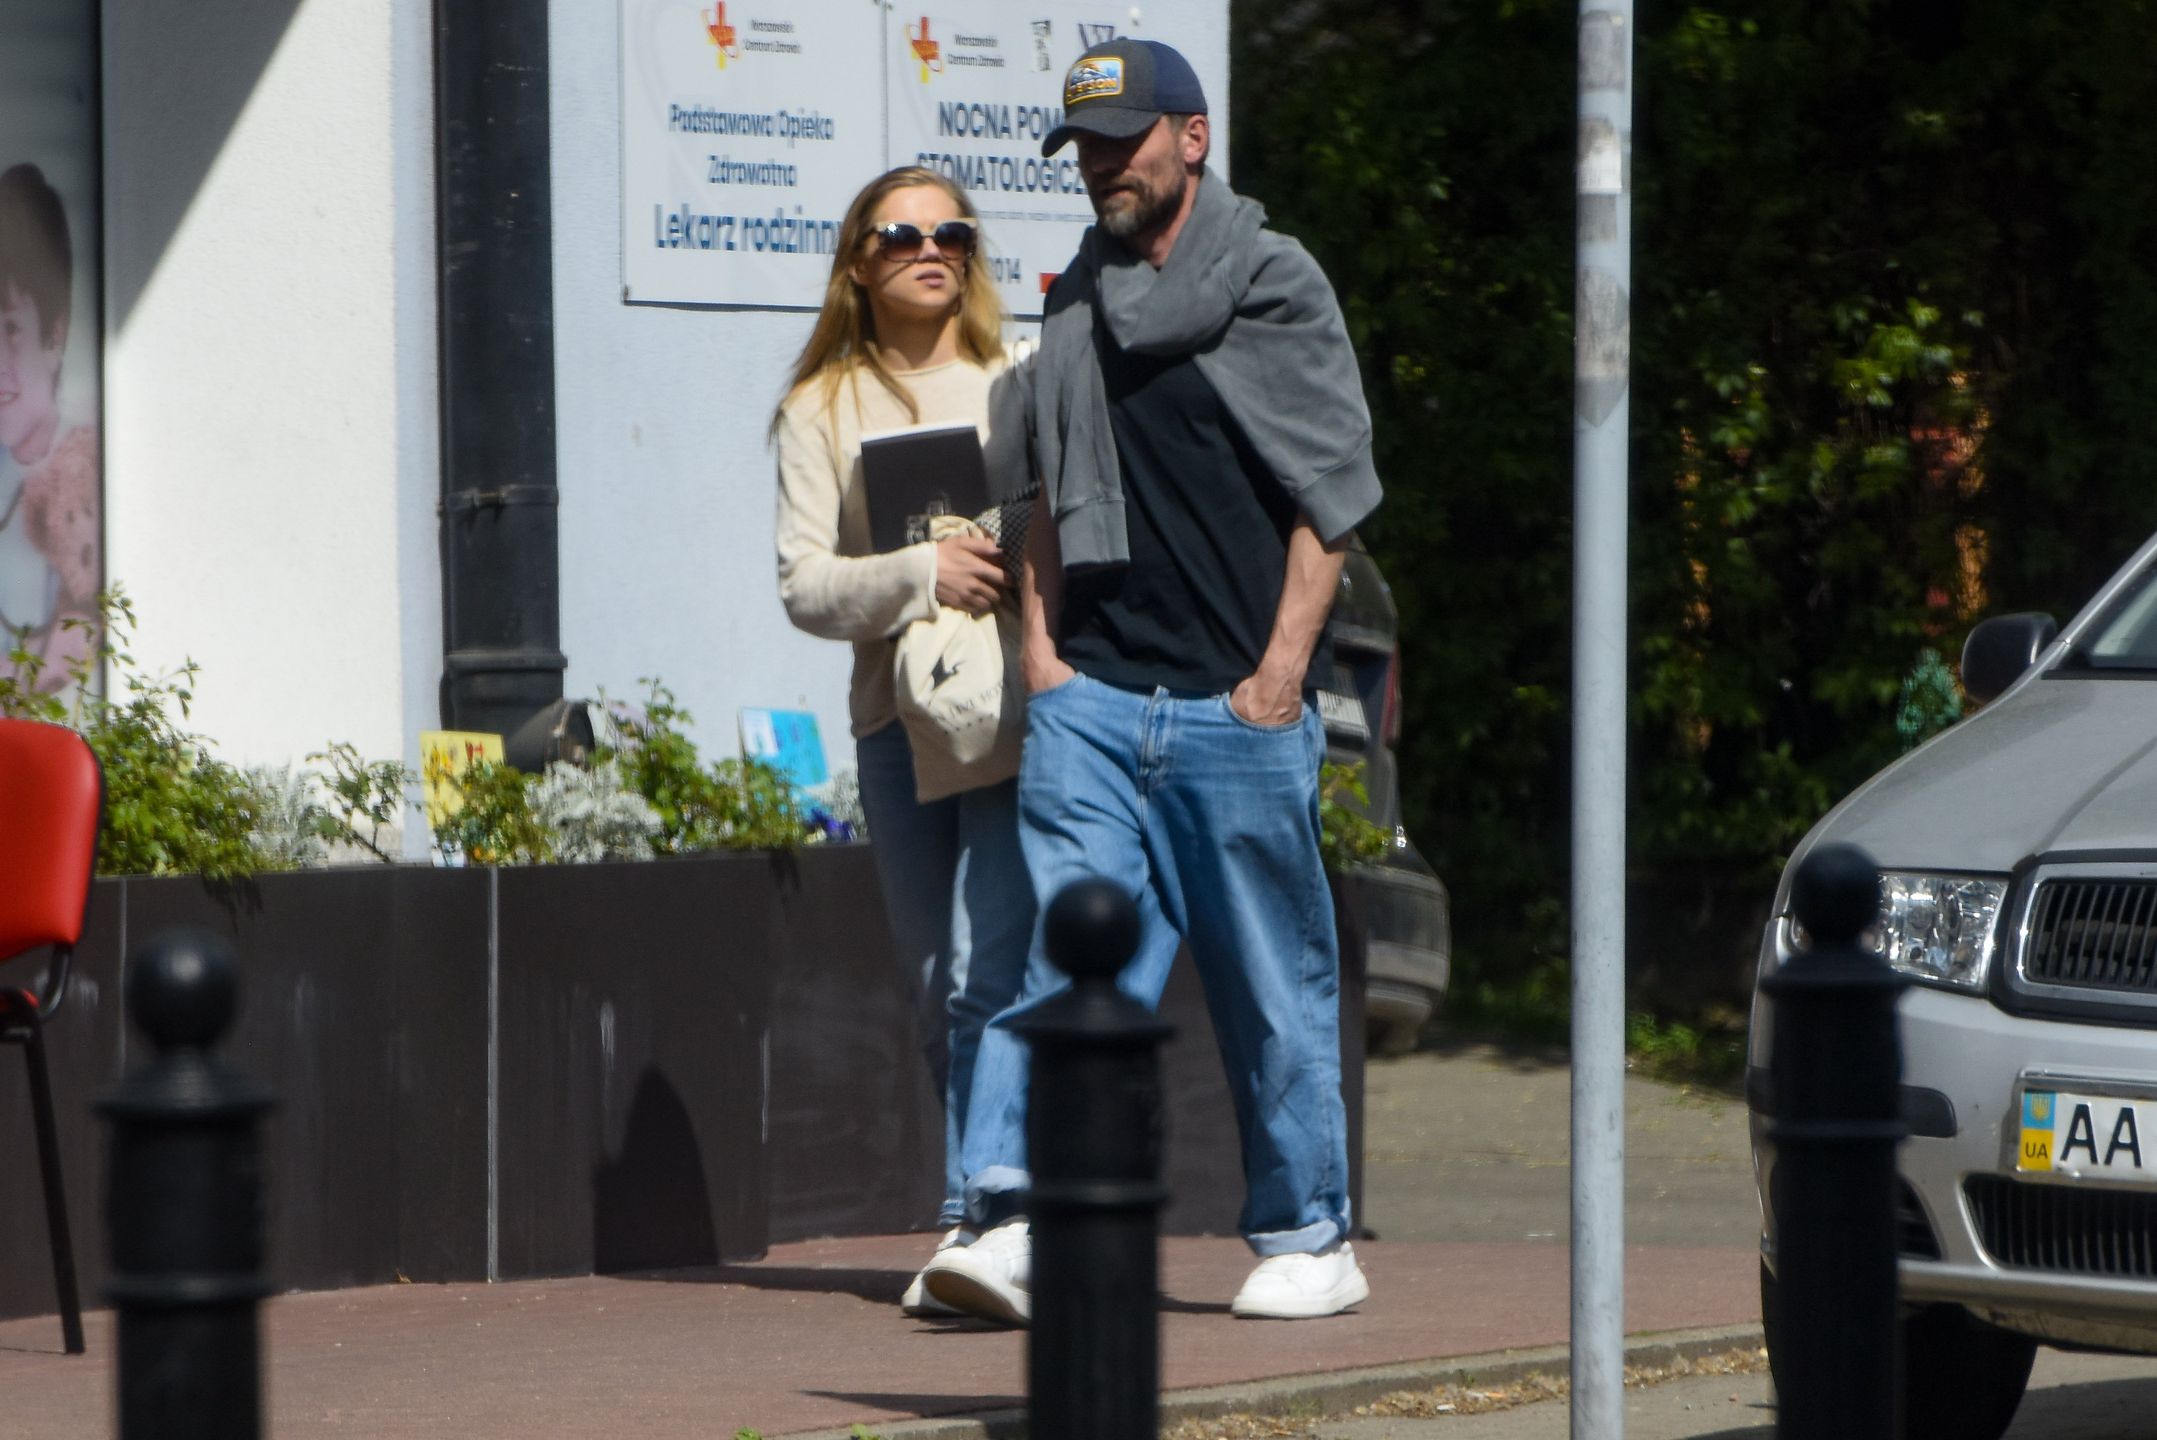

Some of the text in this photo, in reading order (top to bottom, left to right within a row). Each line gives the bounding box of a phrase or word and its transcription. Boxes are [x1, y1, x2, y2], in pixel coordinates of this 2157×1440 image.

[669, 103, 835, 148] Podstawowa Opieka
[939, 101, 1066, 140] NOCNA POM
[708, 155, 797, 186] Zdrowotna
[917, 152, 1089, 195] TOMATOLOGICZ
[654, 203, 737, 252] Lekarz
[2025, 1141, 2048, 1159] UA
[2060, 1103, 2143, 1168] AA
